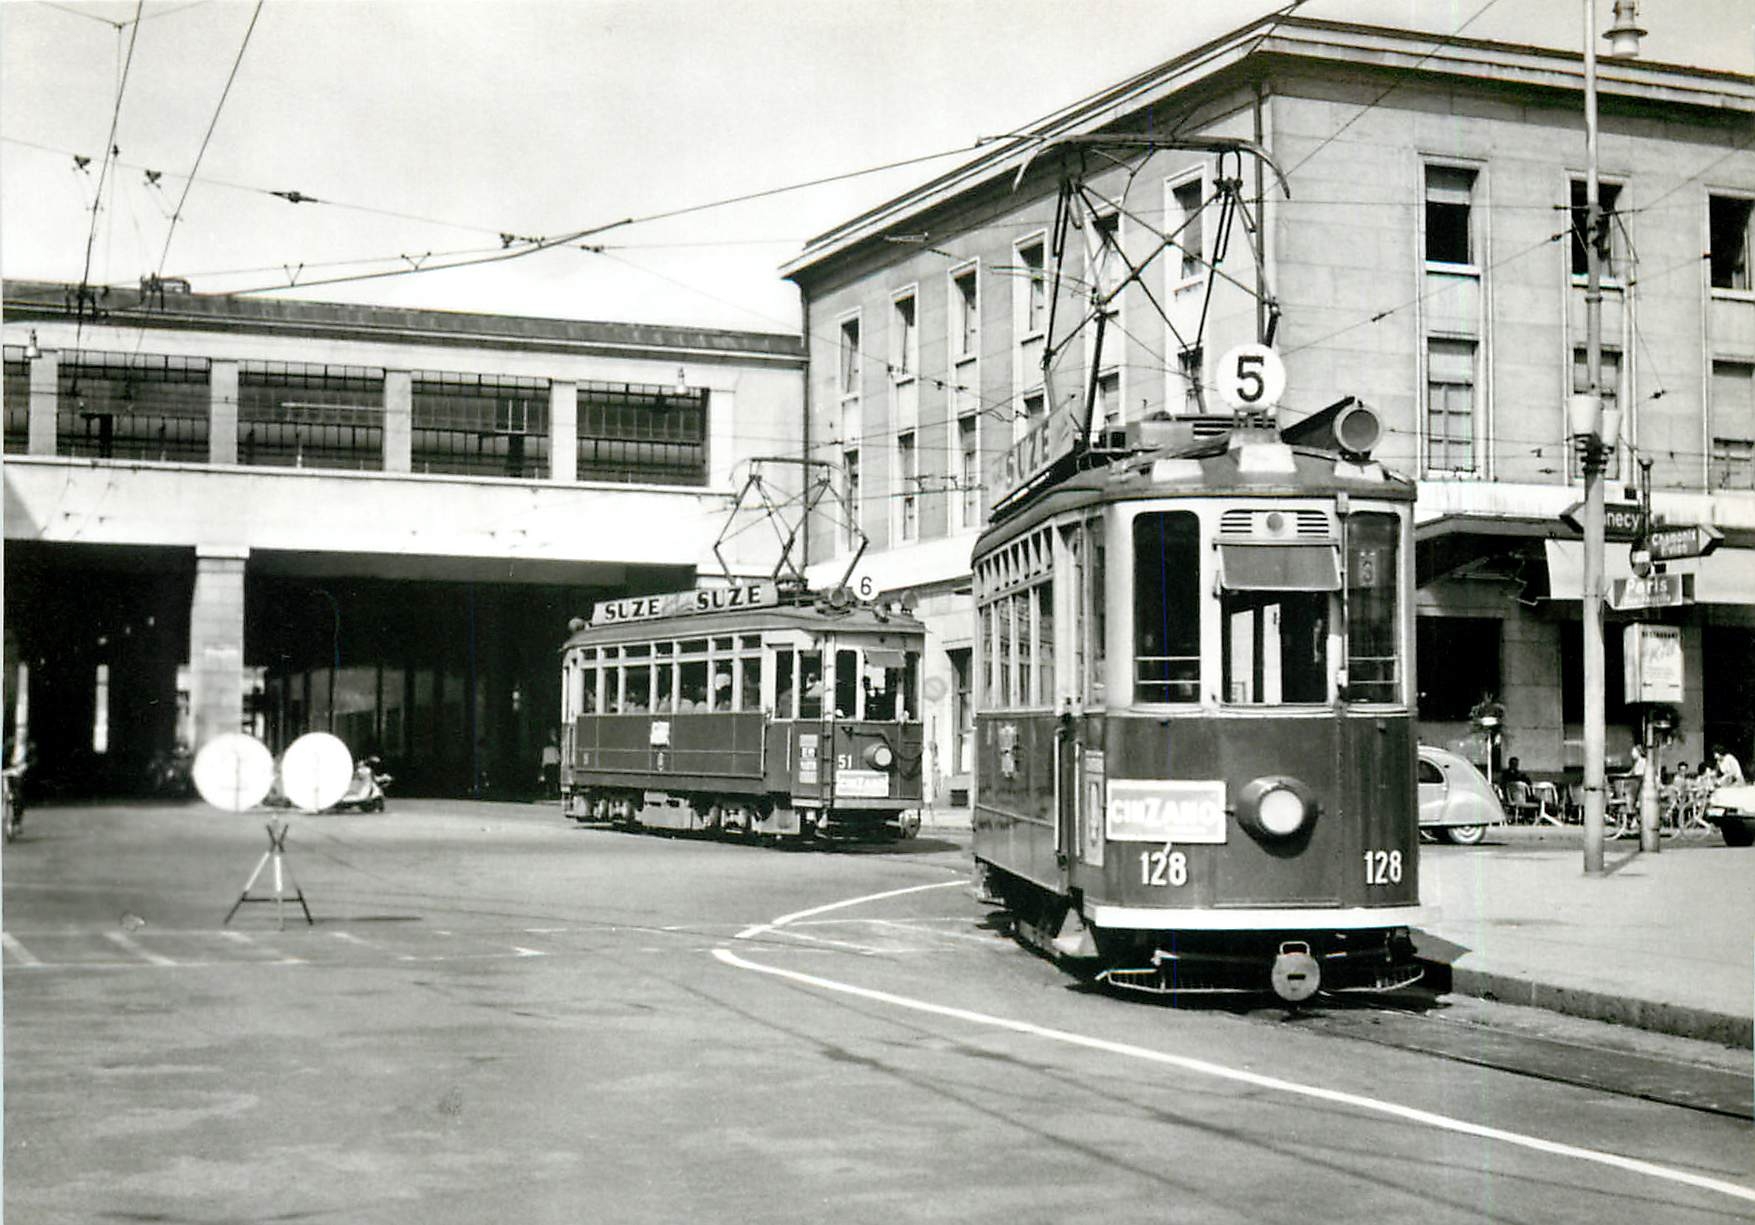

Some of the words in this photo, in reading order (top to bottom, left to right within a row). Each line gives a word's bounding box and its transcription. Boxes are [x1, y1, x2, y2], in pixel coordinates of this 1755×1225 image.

[1236, 355, 1265, 403] 5
[1602, 512, 1640, 532] necy
[860, 576, 872, 596] 6
[1625, 579, 1668, 596] Paris
[605, 598, 659, 621] SUZE
[696, 585, 761, 610] SUZE
[838, 754, 852, 769] 51
[1111, 797, 1218, 827] CINZANO
[1140, 851, 1187, 886] 128
[1364, 850, 1402, 884] 128
